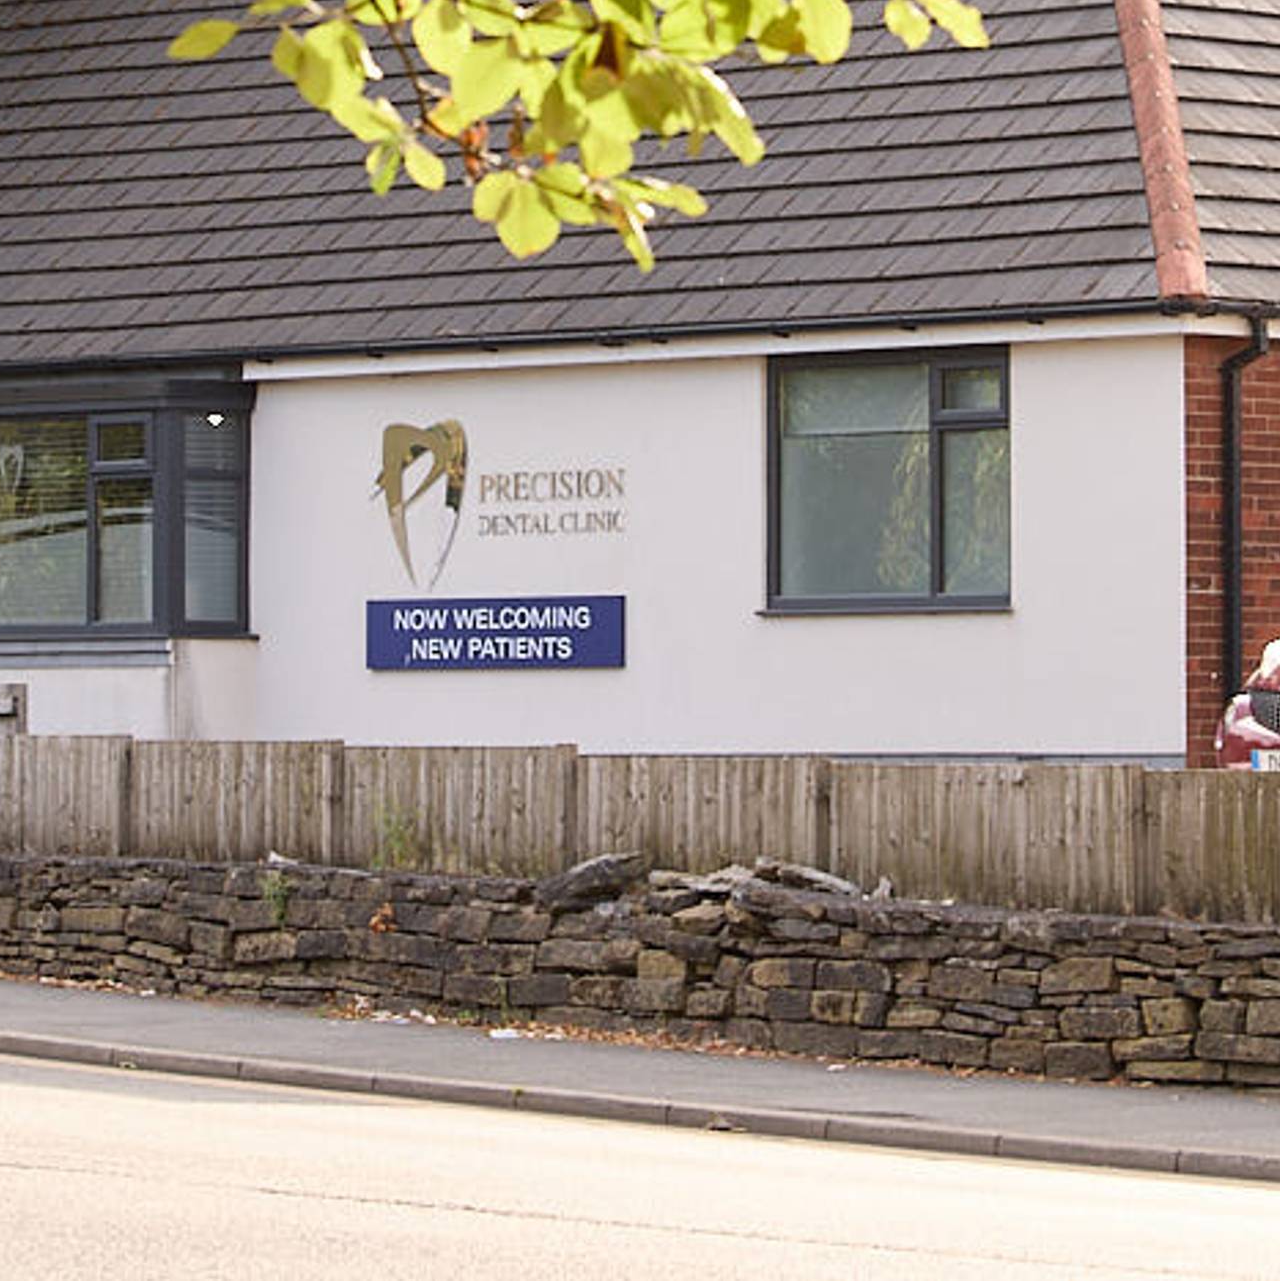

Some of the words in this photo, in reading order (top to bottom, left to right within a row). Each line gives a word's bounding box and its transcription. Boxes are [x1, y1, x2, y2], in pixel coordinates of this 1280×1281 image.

[480, 469, 625, 503] PRECISION
[479, 513, 557, 536] DENTAL
[559, 510, 625, 534] CLINIC
[393, 609, 449, 630] NOW
[453, 606, 591, 629] WELCOMING
[412, 638, 462, 660] NEW
[468, 636, 572, 659] PATIENTS
